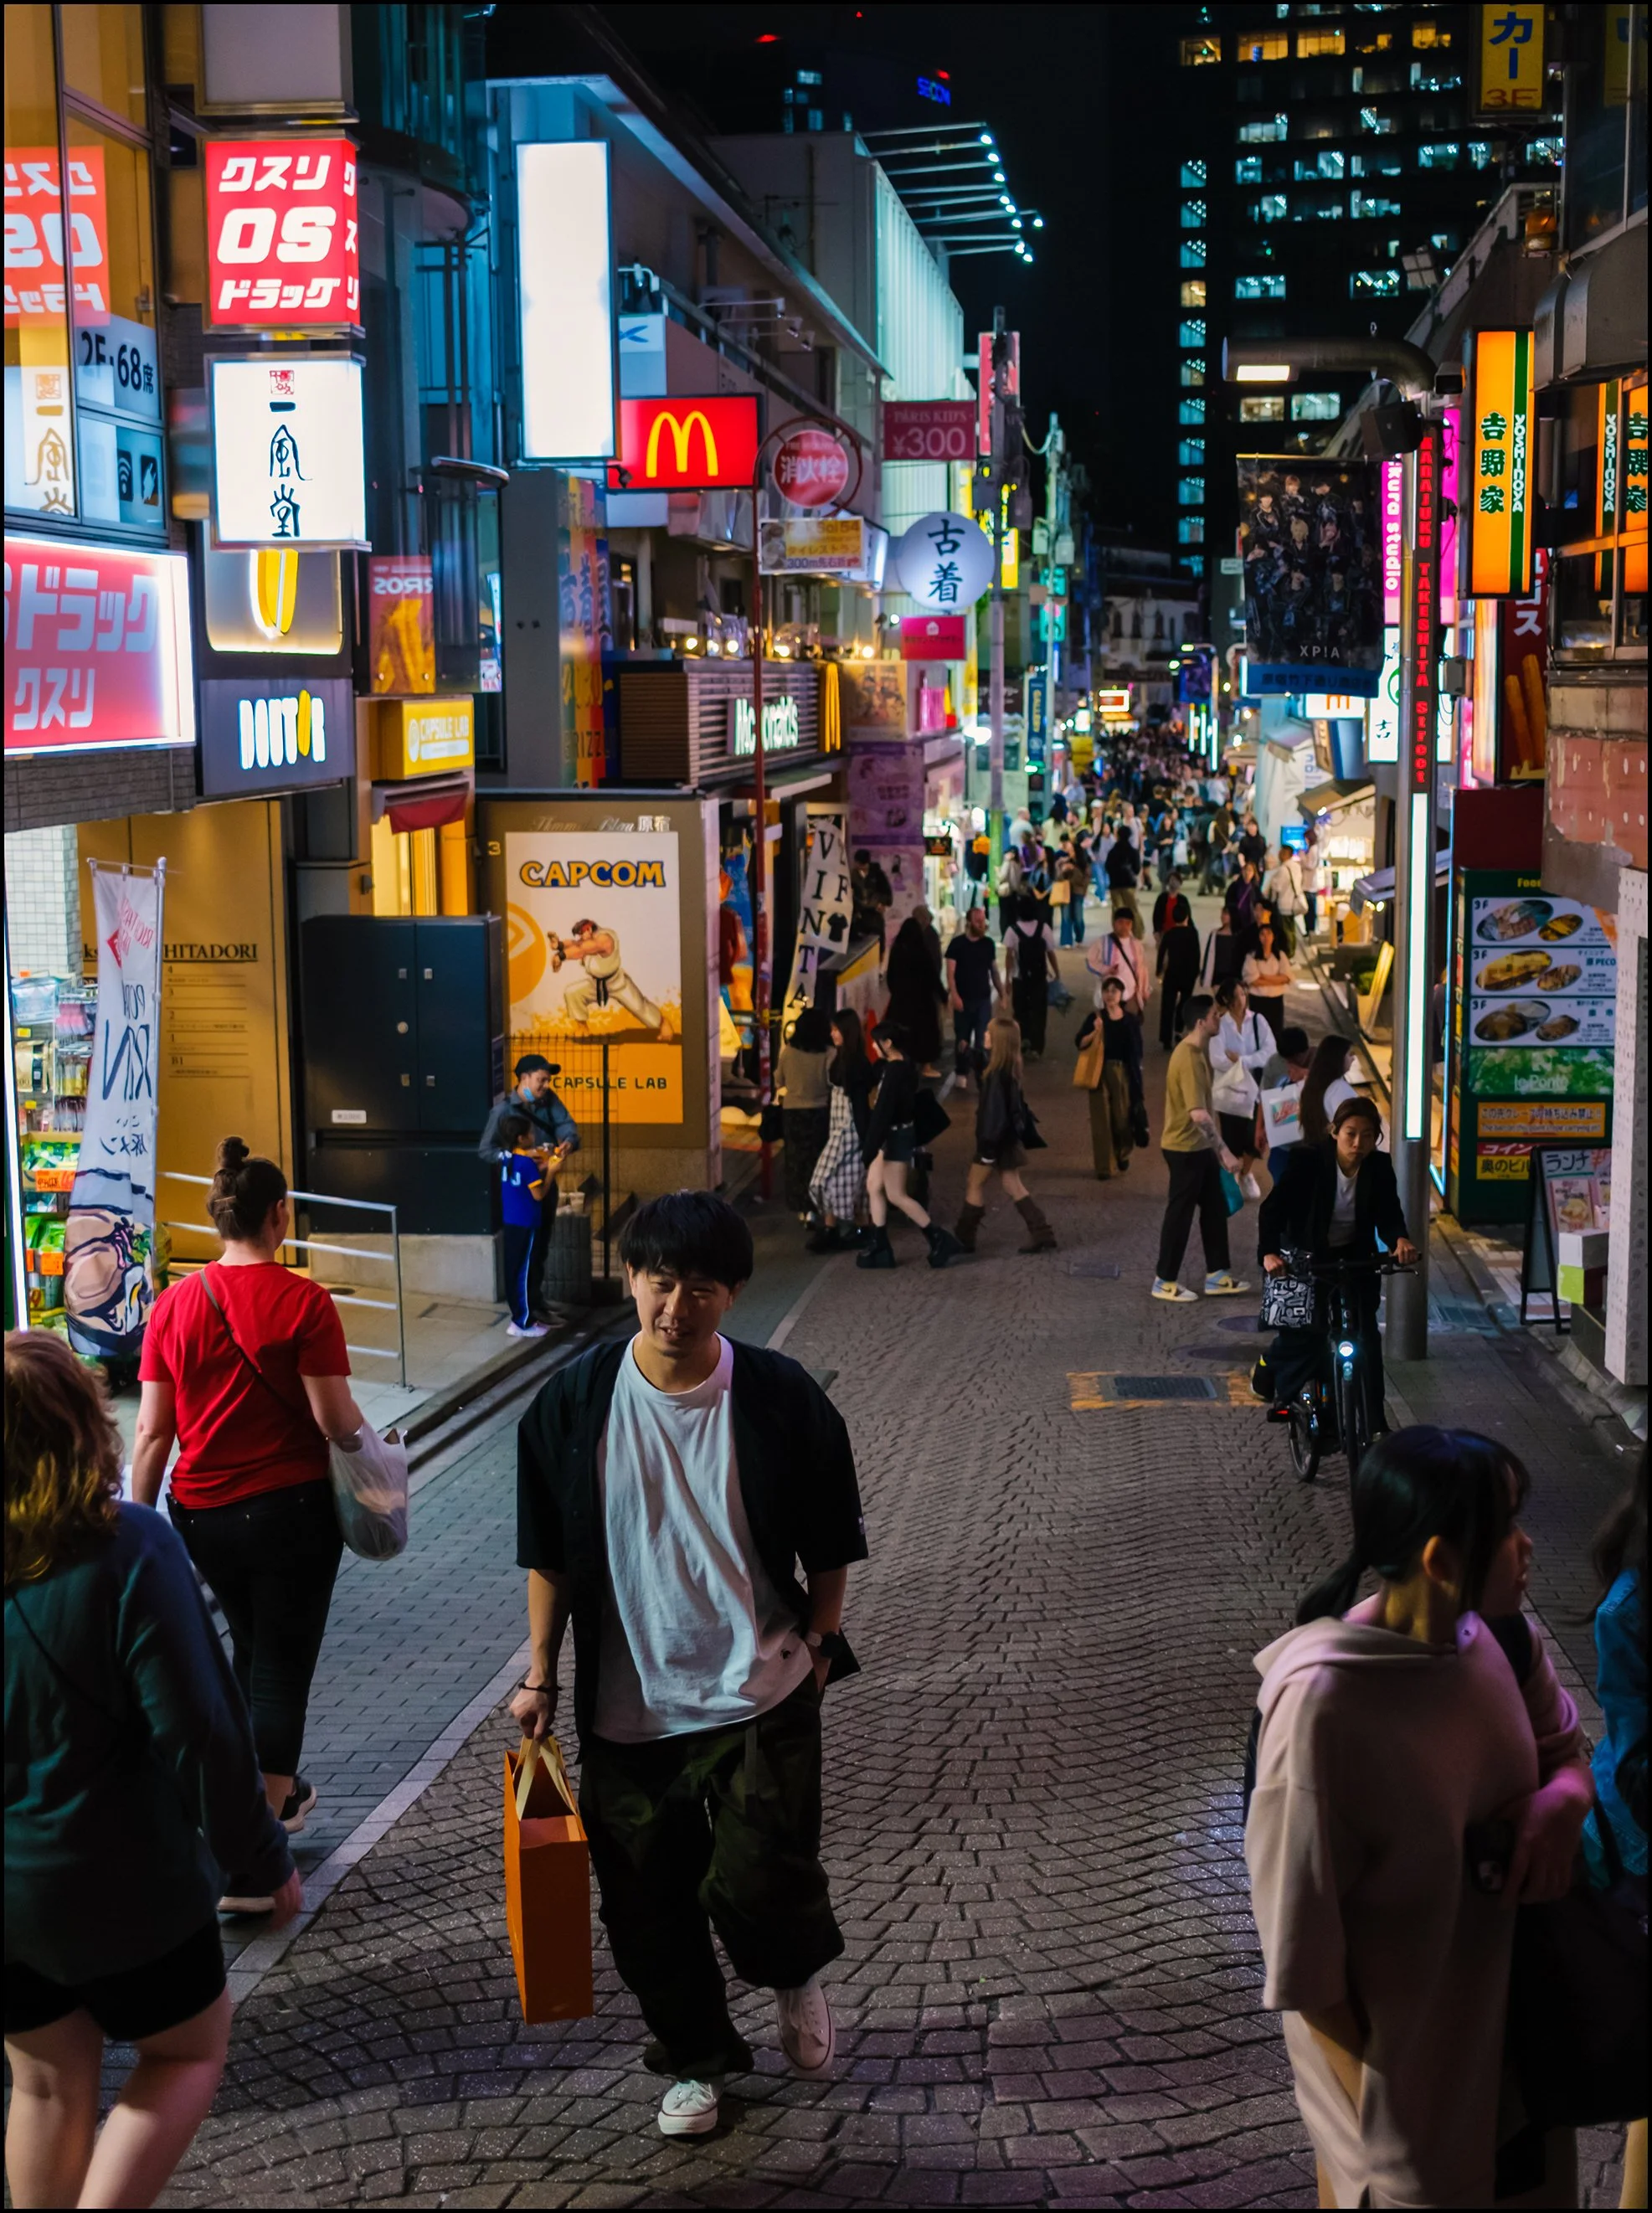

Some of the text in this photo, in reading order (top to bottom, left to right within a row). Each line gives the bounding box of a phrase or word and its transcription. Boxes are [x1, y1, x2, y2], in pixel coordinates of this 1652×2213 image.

[1490, 4, 1533, 80] カー
[1486, 89, 1539, 108] 3F
[219, 155, 332, 192] クスリ
[216, 206, 337, 265] OS
[342, 161, 360, 311] クスリ
[217, 277, 342, 311] ドラッグ
[269, 401, 313, 538] 一風堂
[780, 455, 841, 484] 消火栓
[893, 426, 966, 457] ¥300
[1480, 411, 1507, 514] 吉野家
[1511, 414, 1526, 512] YOSHINOYA
[1385, 461, 1402, 591] kura studio
[927, 518, 965, 604] 古着
[13, 668, 95, 732] クスリ
[519, 861, 666, 888] CAPCOM
[635, 1077, 667, 1089] LAB
[1546, 1150, 1590, 1173] ランチ
